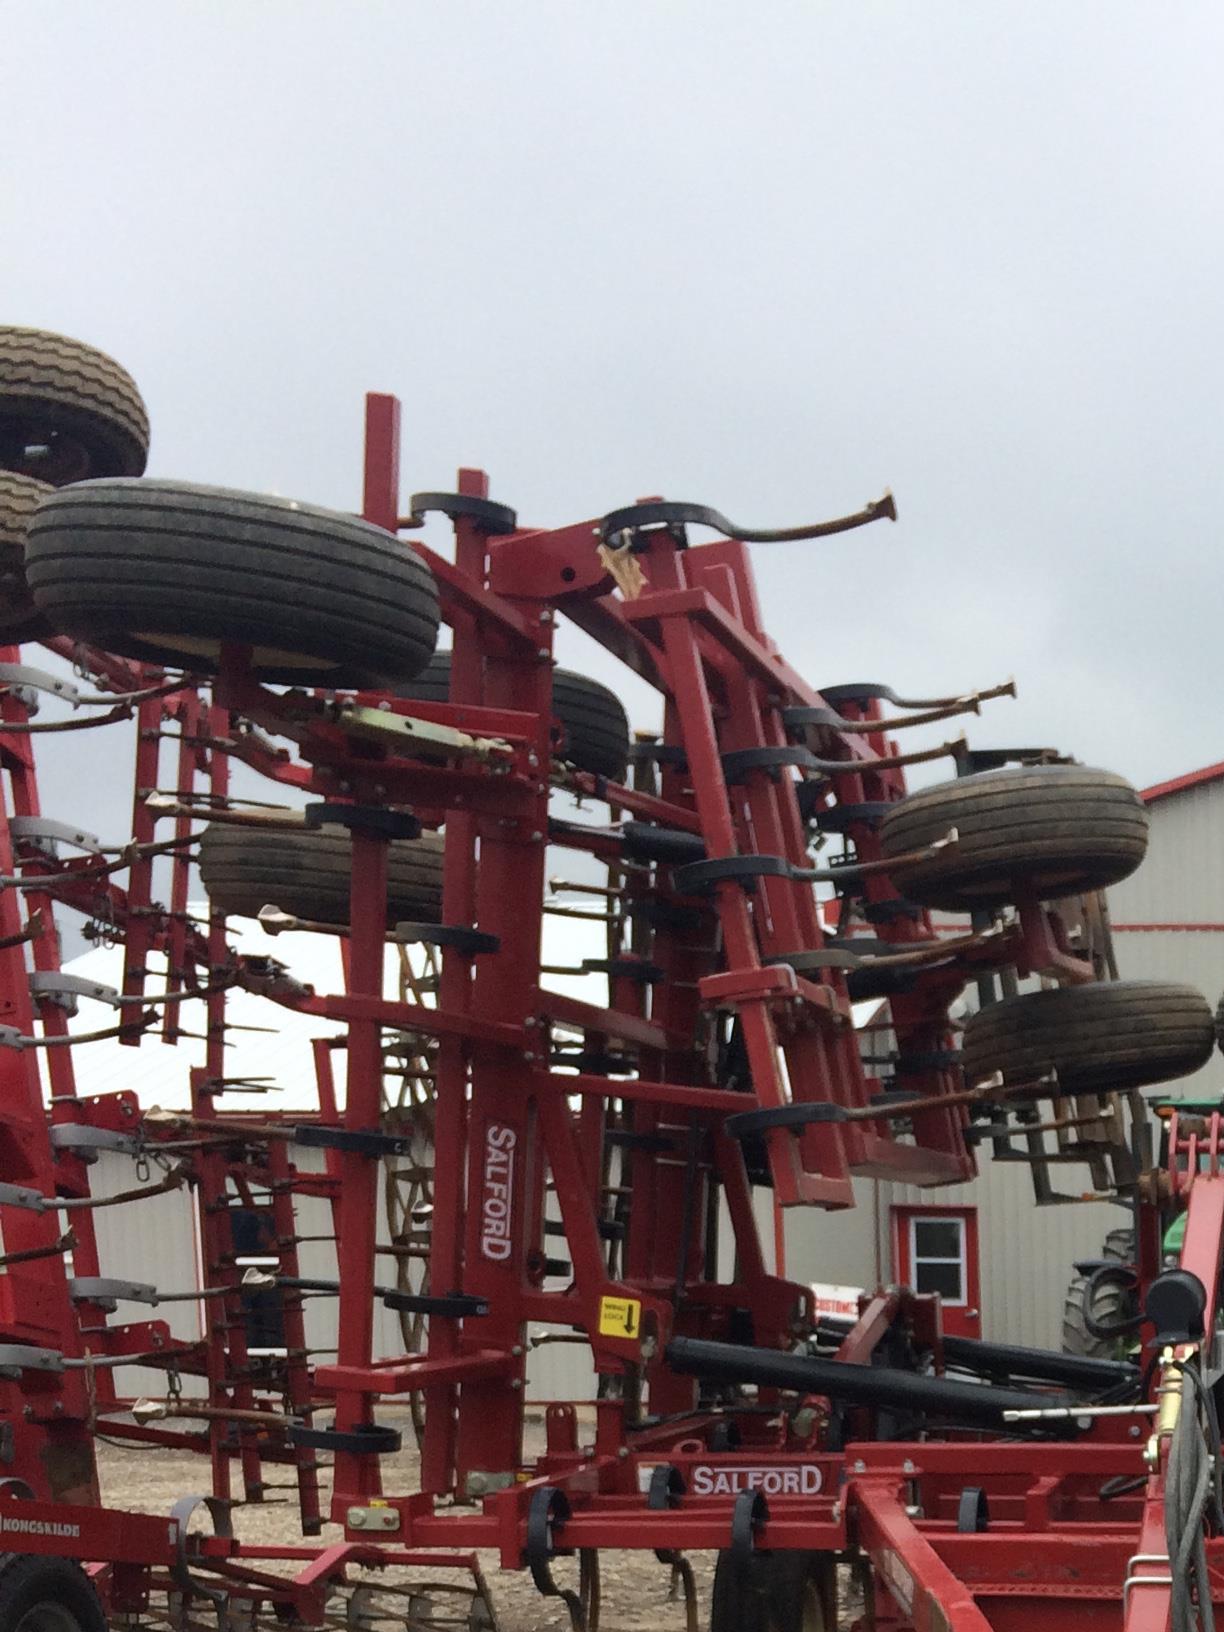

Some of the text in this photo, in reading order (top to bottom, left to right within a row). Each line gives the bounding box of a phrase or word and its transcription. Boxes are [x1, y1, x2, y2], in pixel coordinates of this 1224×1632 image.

[482, 1125, 517, 1260] SALFORD
[693, 1465, 822, 1494] SALFORD
[3, 1518, 81, 1538] KONGSKILDE
